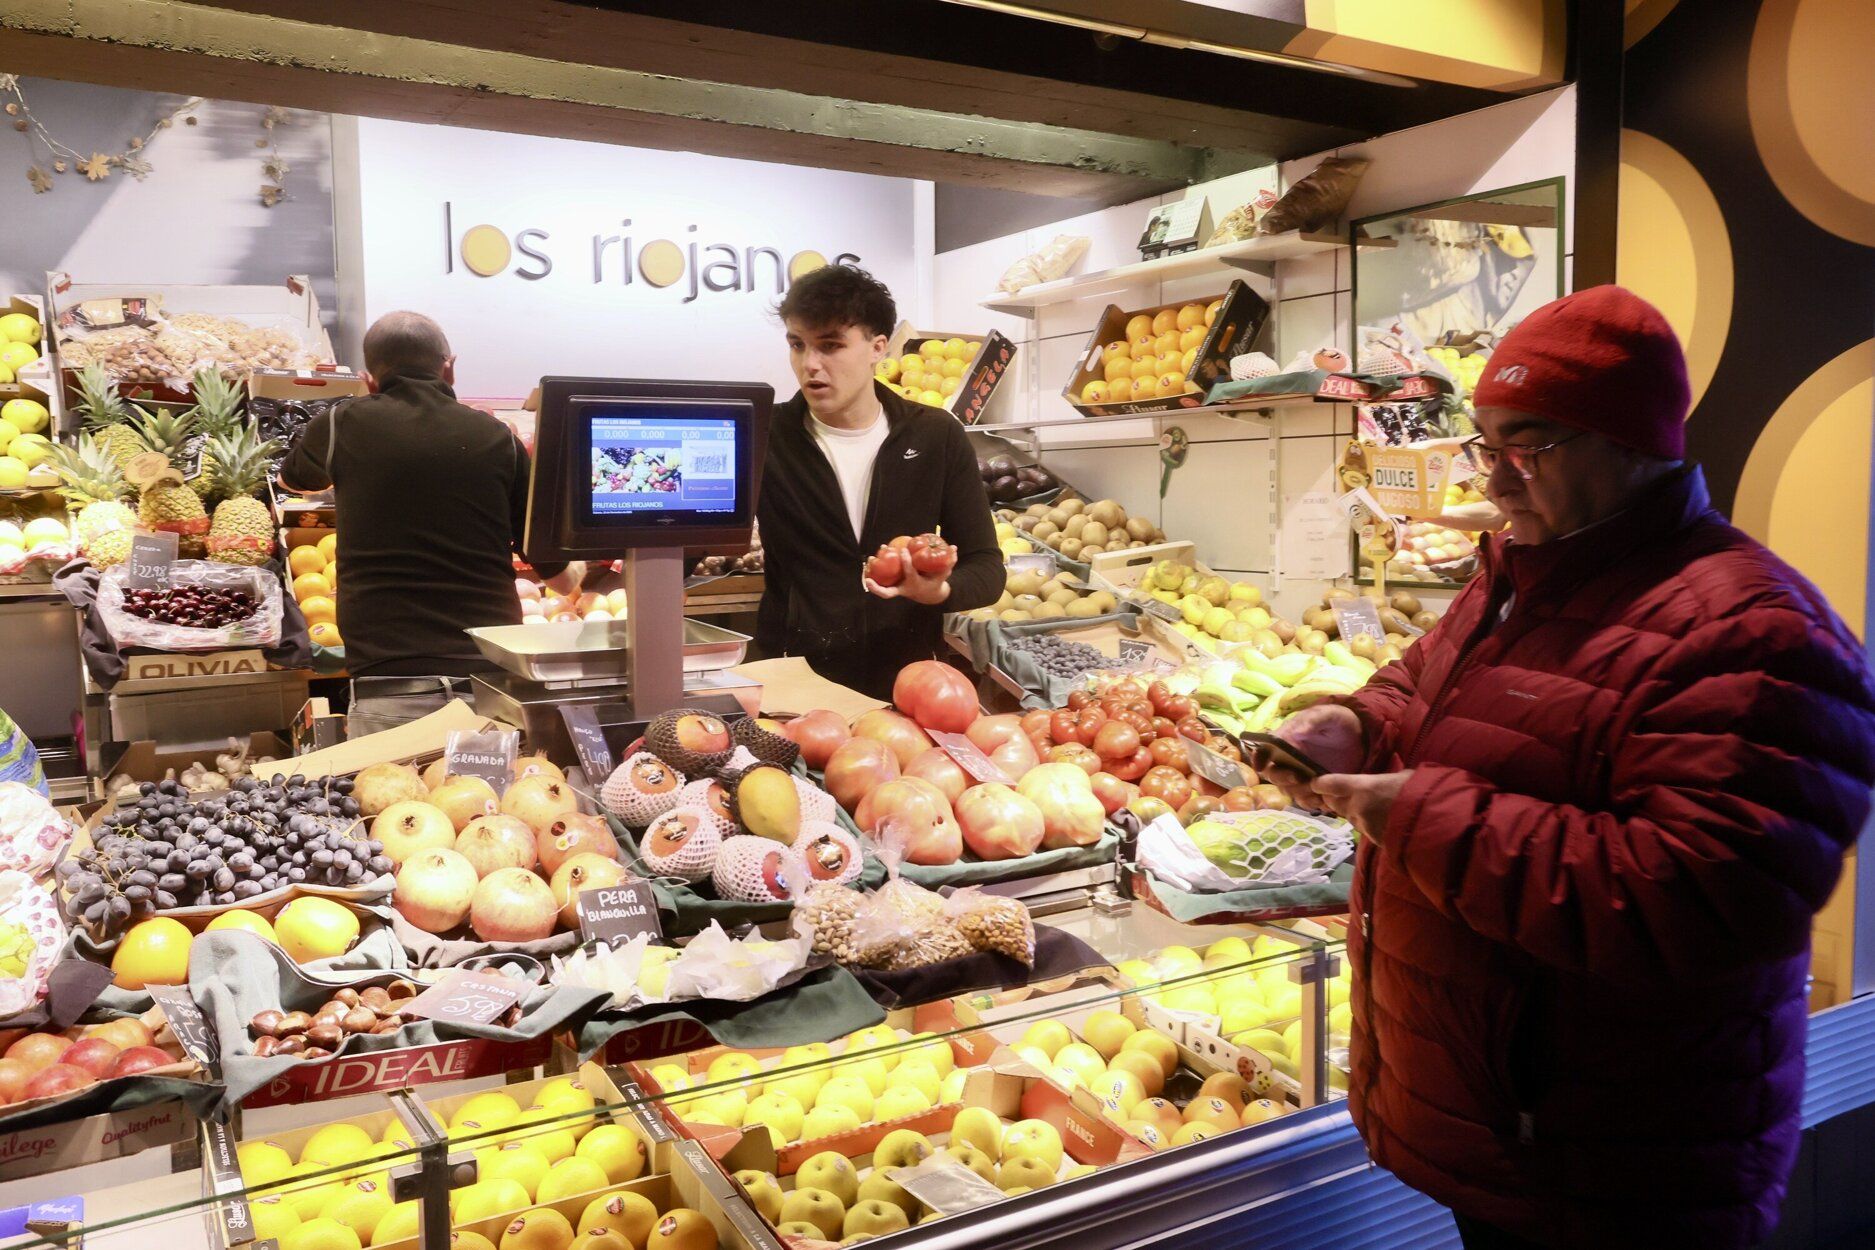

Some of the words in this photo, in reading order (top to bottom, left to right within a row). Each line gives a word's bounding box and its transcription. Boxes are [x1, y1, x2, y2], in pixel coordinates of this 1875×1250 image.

[442, 201, 552, 281] los
[1376, 469, 1415, 488] DULCE
[140, 659, 256, 679] OLIVIA
[452, 753, 505, 766] GRANADA
[598, 889, 638, 907] PERA
[586, 905, 647, 922] BLANQUILLA
[314, 1048, 465, 1095] IDEAL
[102, 1113, 172, 1145] Qualityfrut
[1065, 1117, 1095, 1148] FRANCE
